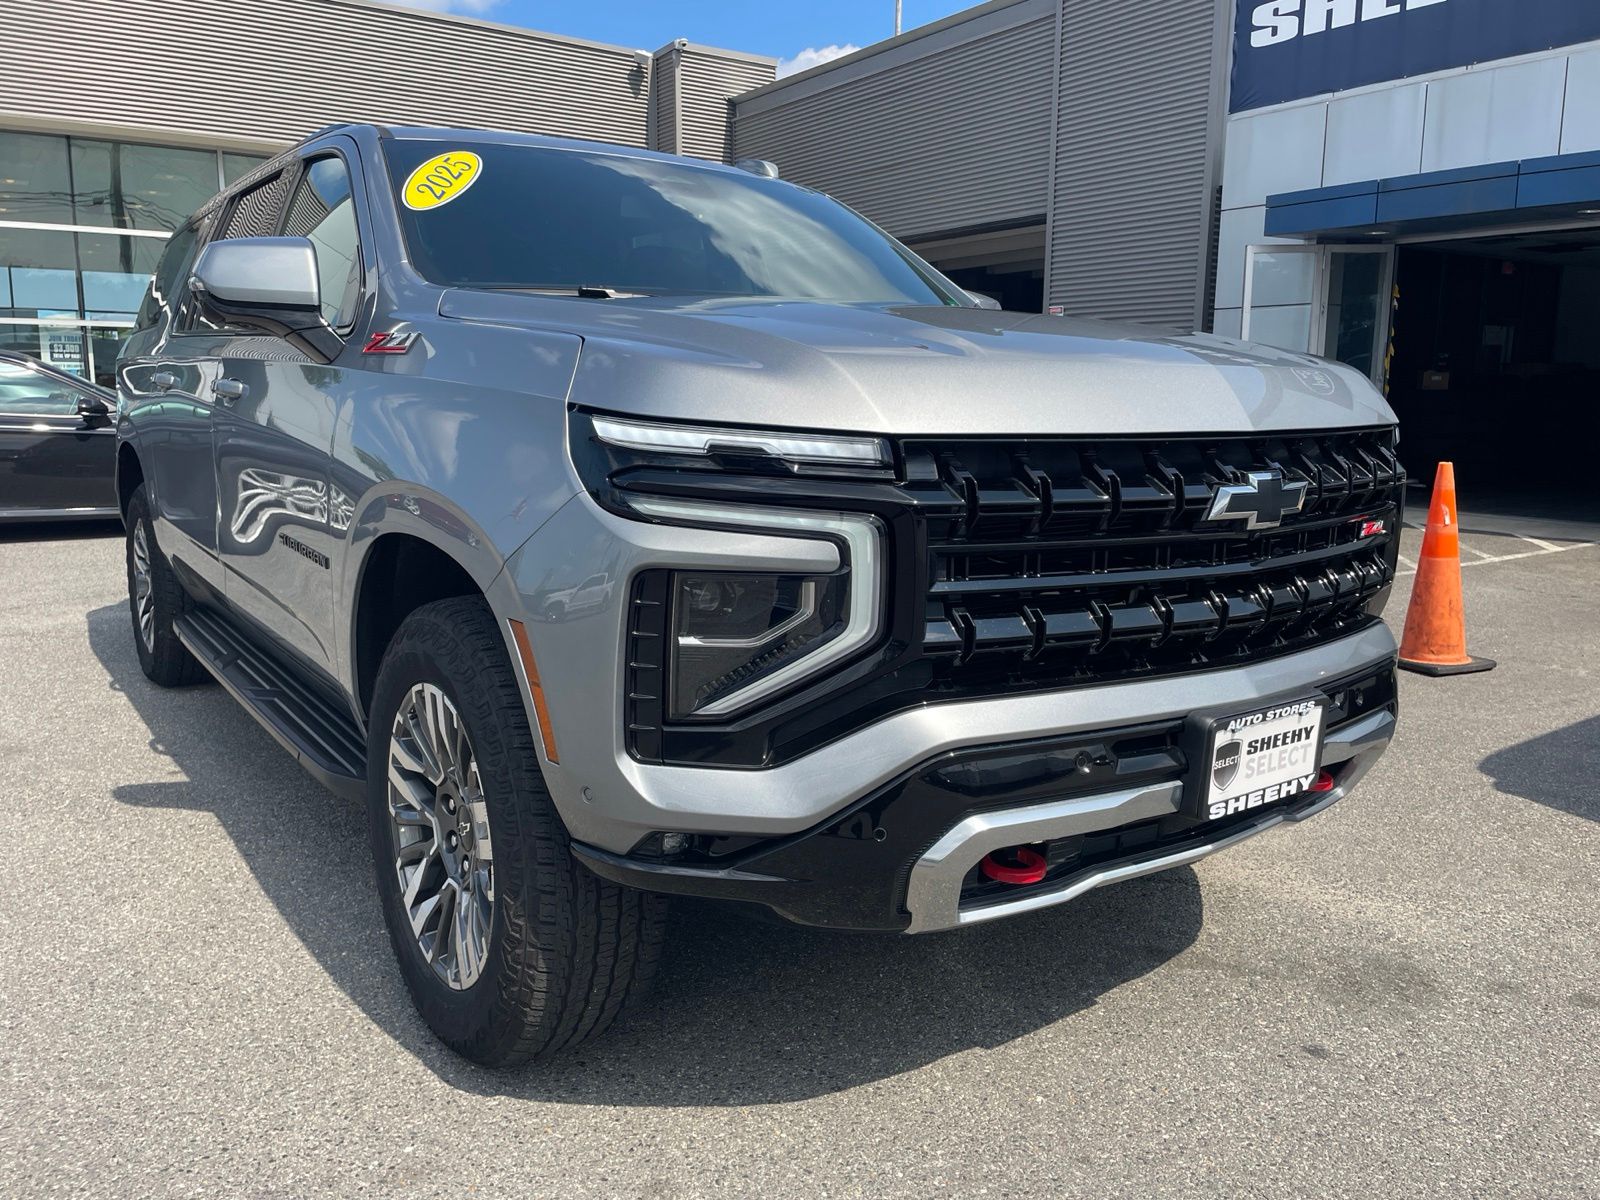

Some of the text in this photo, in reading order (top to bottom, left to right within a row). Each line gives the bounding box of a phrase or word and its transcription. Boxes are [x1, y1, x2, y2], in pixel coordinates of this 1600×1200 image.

[1250, 0, 1447, 48] SH
[416, 157, 471, 200] 2025
[279, 532, 330, 570] SUBURBAN
[1227, 700, 1316, 731] AUTO STORES
[1246, 725, 1315, 755] SHEEHY
[1213, 755, 1239, 770] SELECT
[1245, 743, 1313, 779] SELECT
[1208, 773, 1316, 820] SHEEHY
